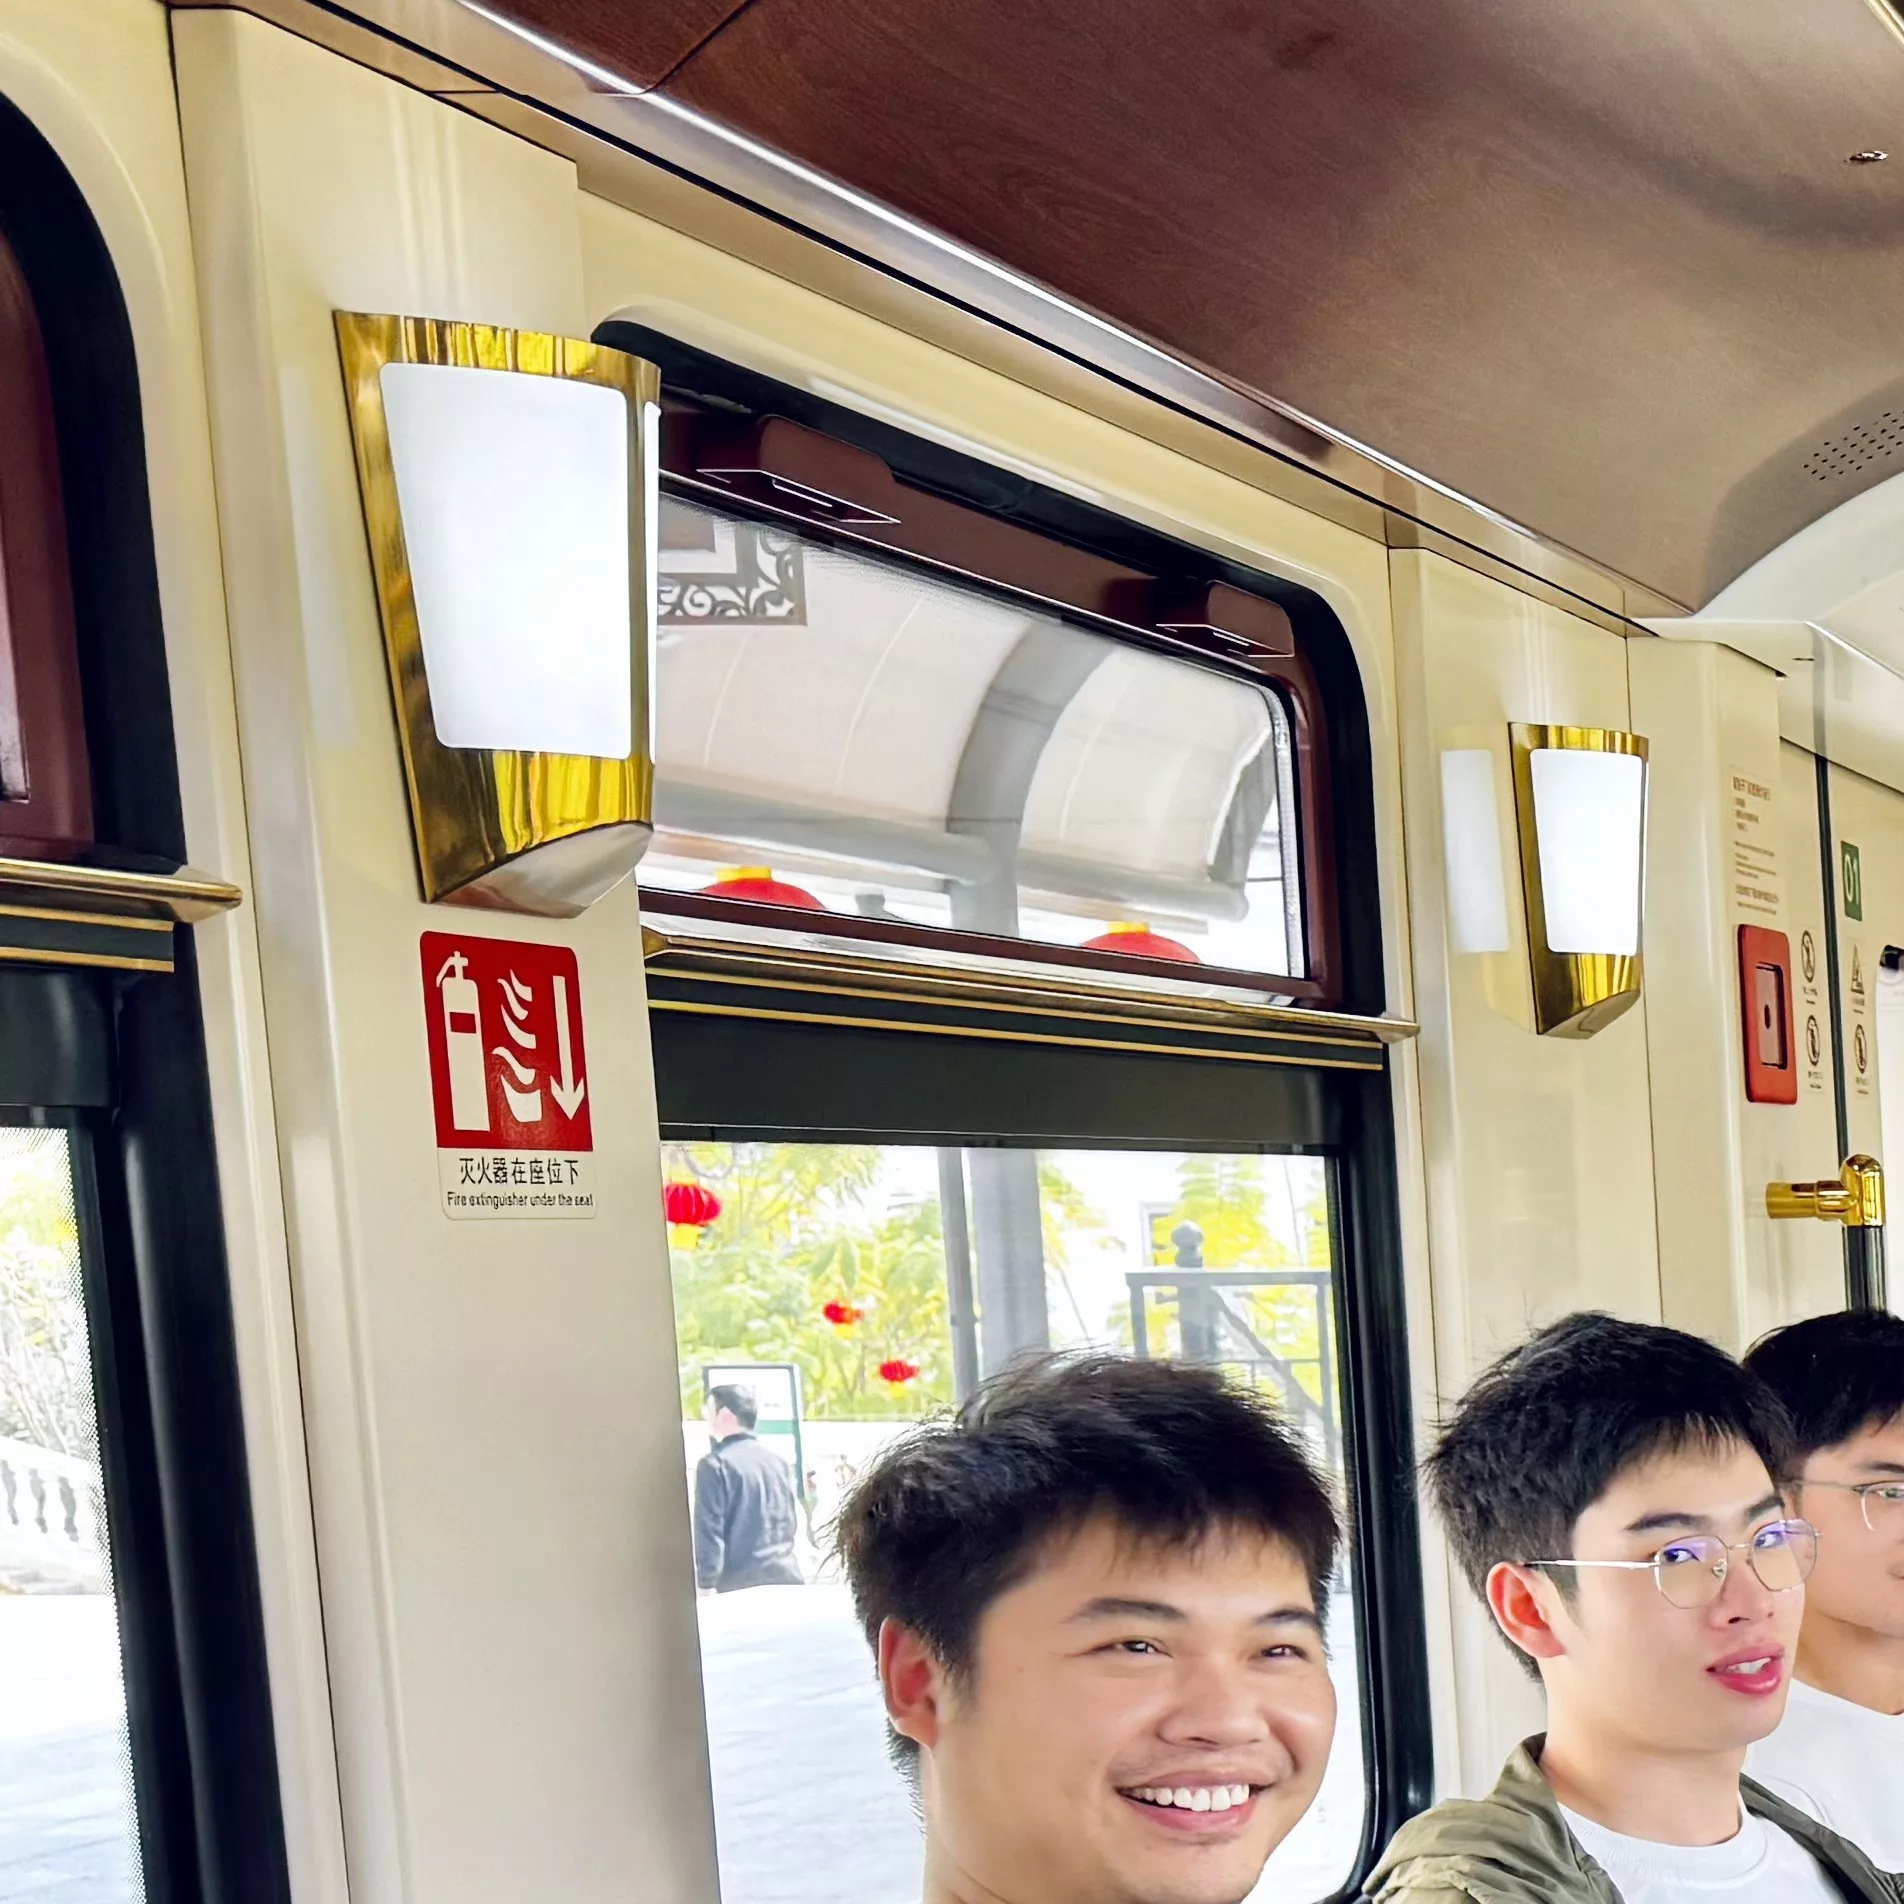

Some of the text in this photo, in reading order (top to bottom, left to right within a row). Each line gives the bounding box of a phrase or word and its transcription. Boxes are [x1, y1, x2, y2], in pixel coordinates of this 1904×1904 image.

[1844, 854, 1861, 905] 01
[459, 1156, 579, 1185] 灭火器在座位下
[447, 1191, 594, 1210] Fire extinguisher under the seat
